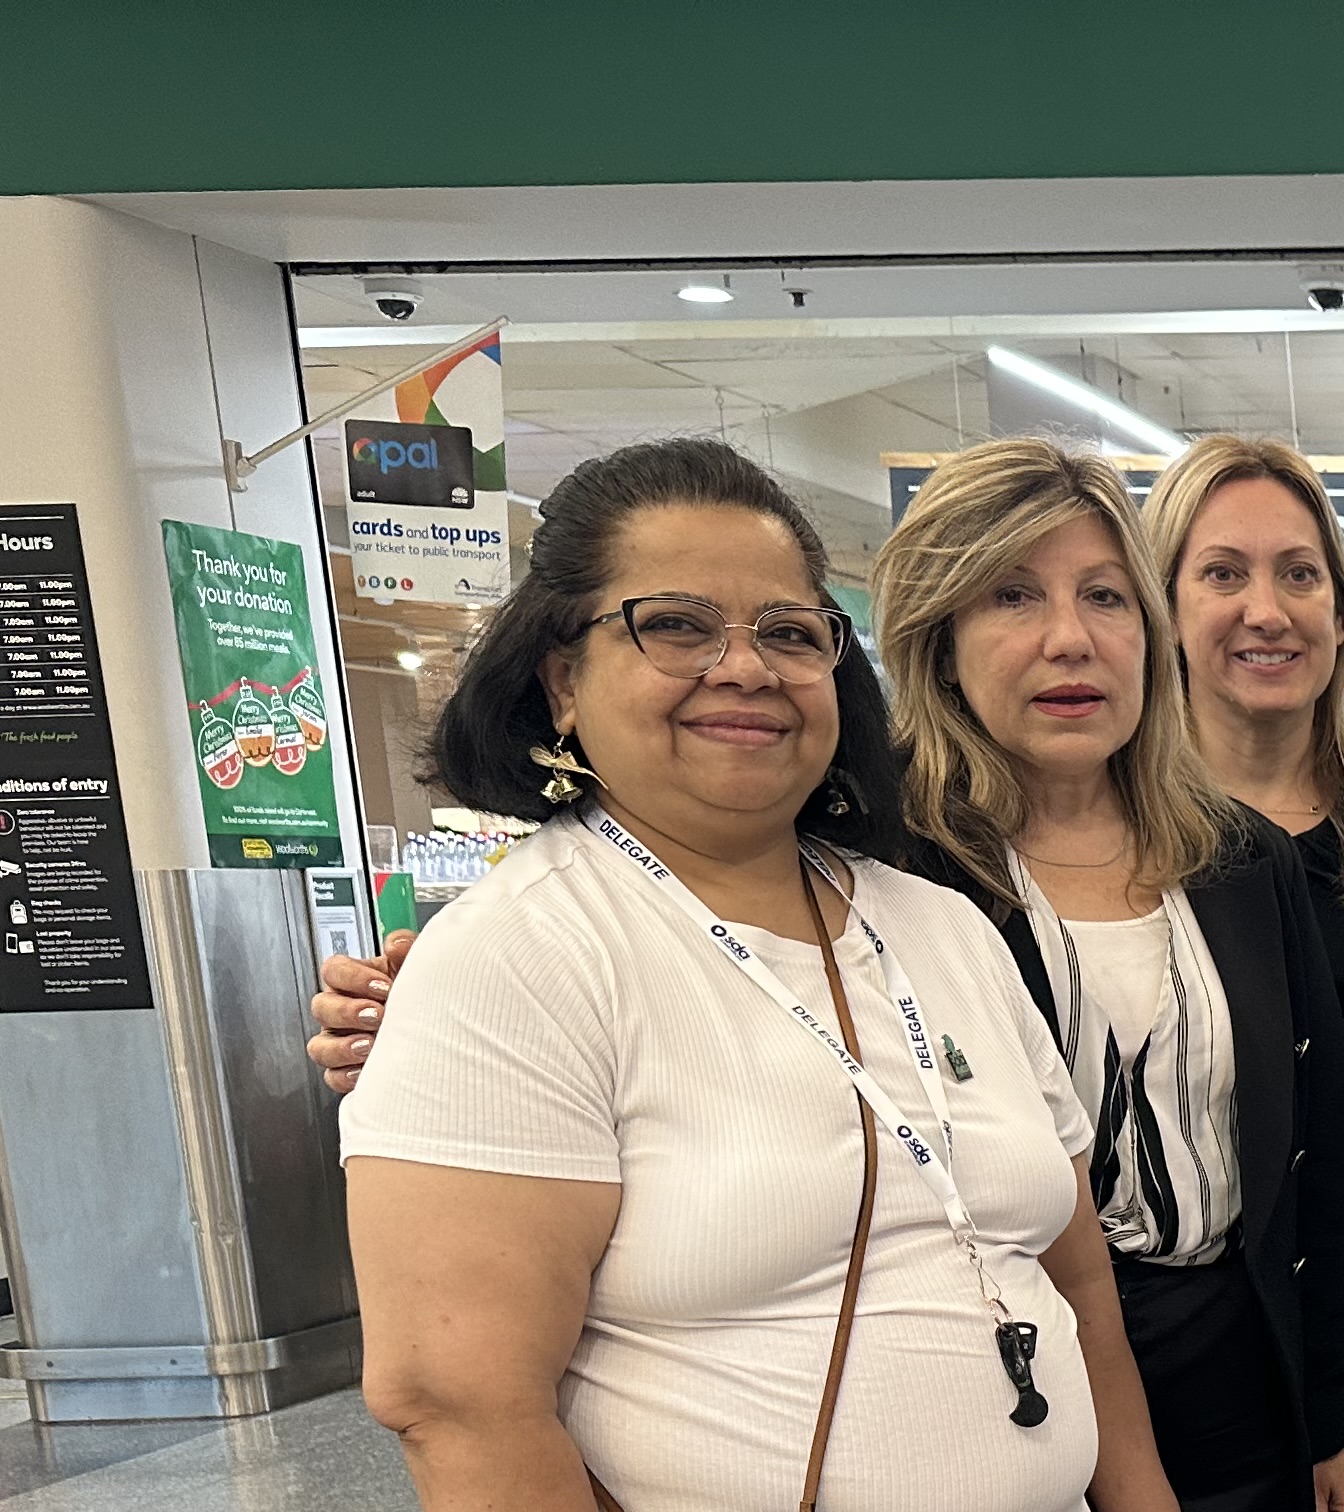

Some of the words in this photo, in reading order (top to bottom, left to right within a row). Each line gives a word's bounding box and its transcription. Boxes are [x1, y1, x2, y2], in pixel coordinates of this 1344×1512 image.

[353, 437, 438, 475] opal
[352, 518, 404, 537] cards
[406, 526, 429, 540] and
[430, 523, 461, 545] top
[465, 529, 501, 547] ups
[375, 541, 406, 555] ticket
[408, 545, 420, 556] to
[422, 545, 450, 558] public
[452, 547, 501, 562] transport
[192, 549, 242, 577] Thank
[241, 562, 271, 585] you
[269, 561, 287, 586] for
[0, 582, 27, 591] .00am
[196, 585, 233, 608] your
[234, 585, 293, 615] donation
[52, 778, 67, 792] of
[69, 778, 108, 793] entry
[600, 819, 671, 880] DELEGATE
[724, 936, 750, 960] sda
[792, 1005, 863, 1075] DELEGATE
[898, 996, 934, 1070] DELEGATE
[909, 1138, 932, 1165] sda
